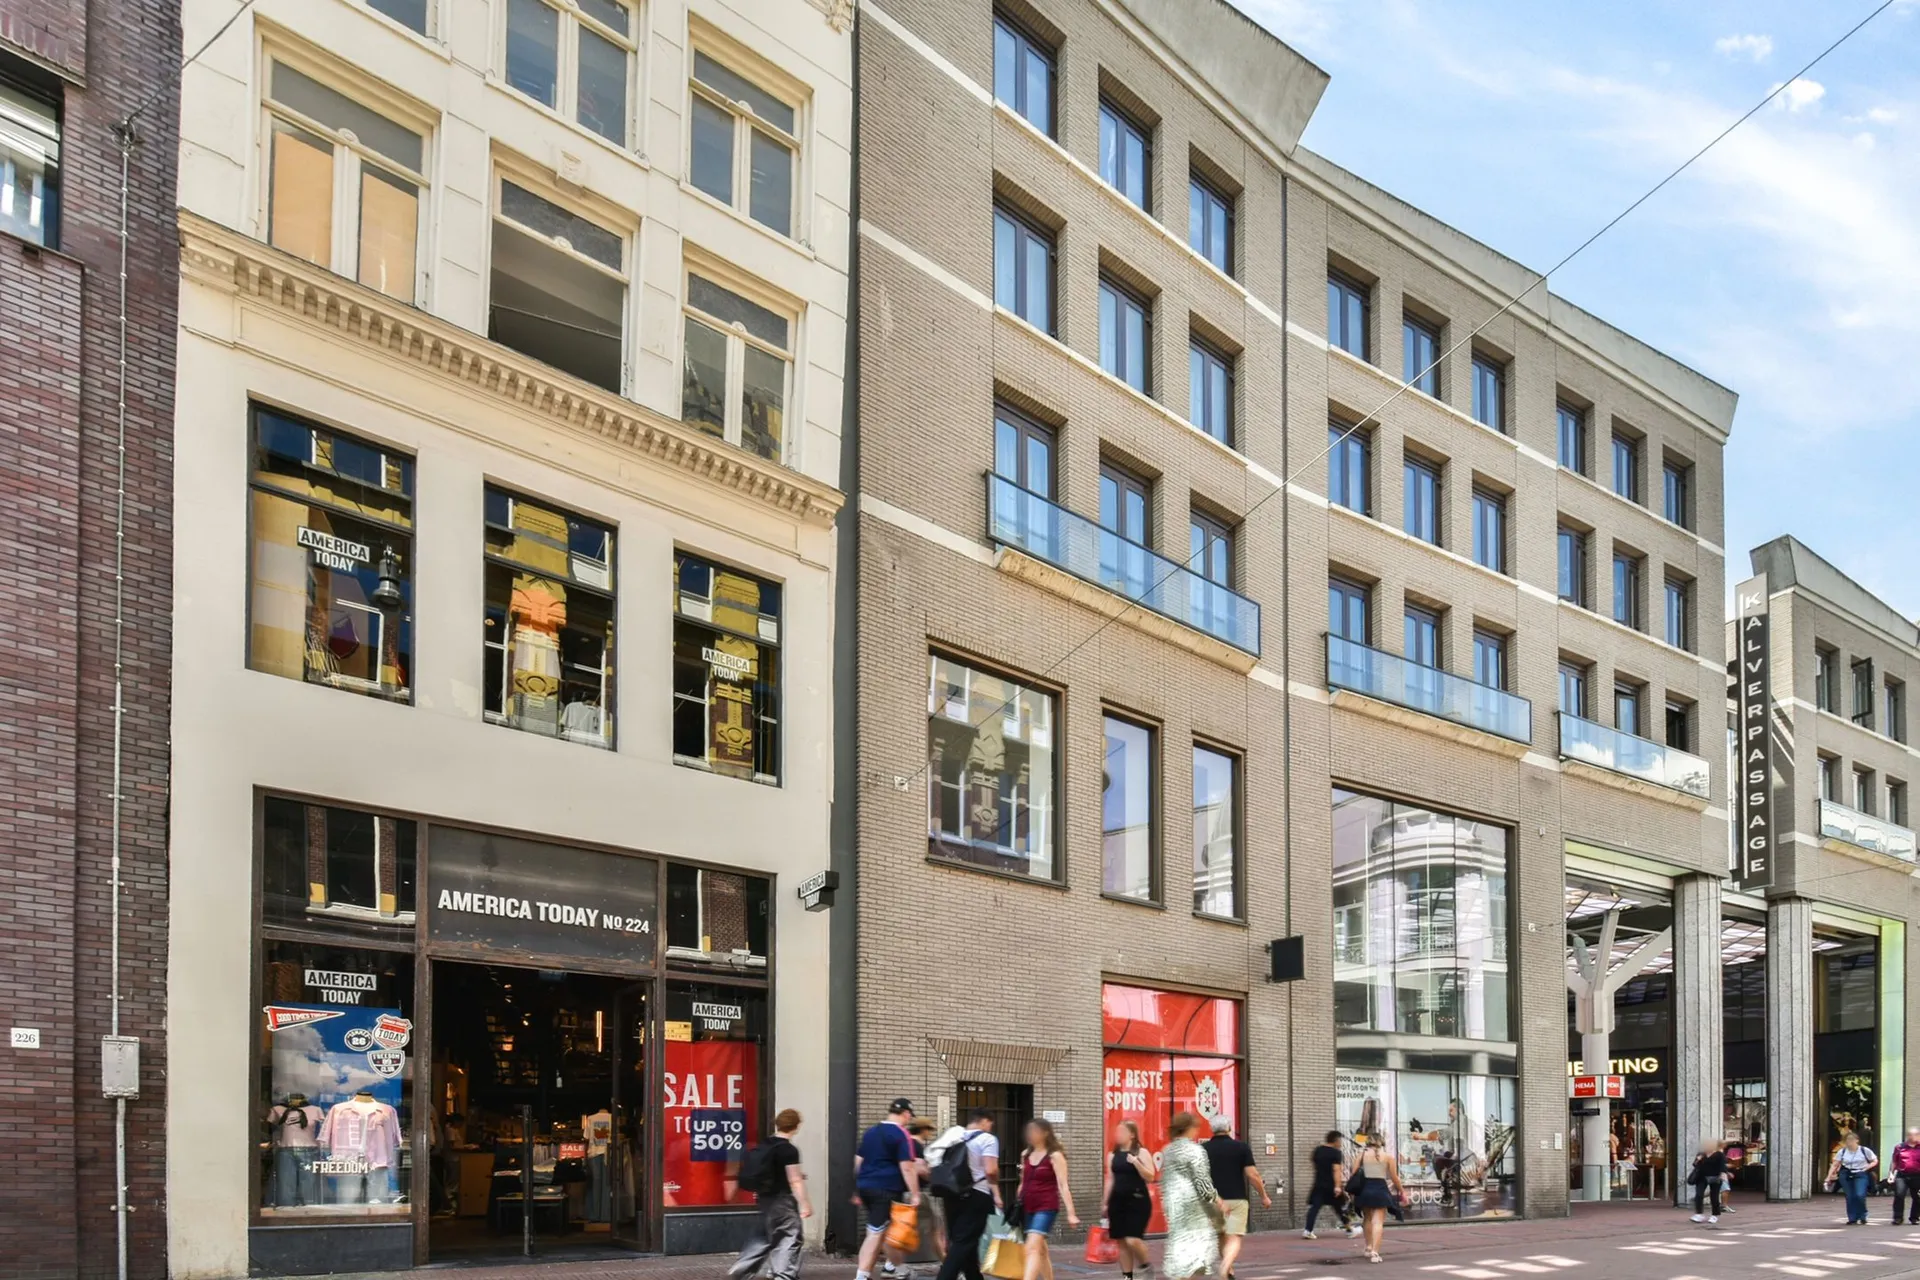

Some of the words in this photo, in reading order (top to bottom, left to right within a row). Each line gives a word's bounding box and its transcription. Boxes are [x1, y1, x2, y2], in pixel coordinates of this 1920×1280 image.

[301, 531, 367, 559] AMERICA
[314, 550, 355, 573] TODAY
[704, 650, 748, 671] AMERICA
[713, 665, 740, 682] TODAY
[1744, 592, 1766, 873] KALVERPASSAGE
[801, 873, 825, 895] AMERICA
[438, 889, 532, 920] AMERICA
[536, 902, 599, 928] TODAY
[625, 918, 650, 934] 224
[307, 971, 374, 989] AMERICA
[321, 989, 361, 1004] TODAY
[694, 1004, 740, 1018] AMERICA
[703, 1018, 731, 1030] TODAY
[15, 1033, 36, 1043] 226
[352, 1037, 366, 1045] 26
[379, 1030, 405, 1042] TODAY
[1105, 1068, 1121, 1087] DE
[1125, 1070, 1163, 1090] BESTE
[664, 1072, 743, 1108] SALE
[1105, 1092, 1146, 1111] SPOTS
[693, 1120, 717, 1132] UP
[721, 1120, 743, 1132] TO
[561, 1144, 585, 1152] SALE
[693, 1134, 743, 1150] 50%
[312, 1161, 368, 1174] FREEDOM
